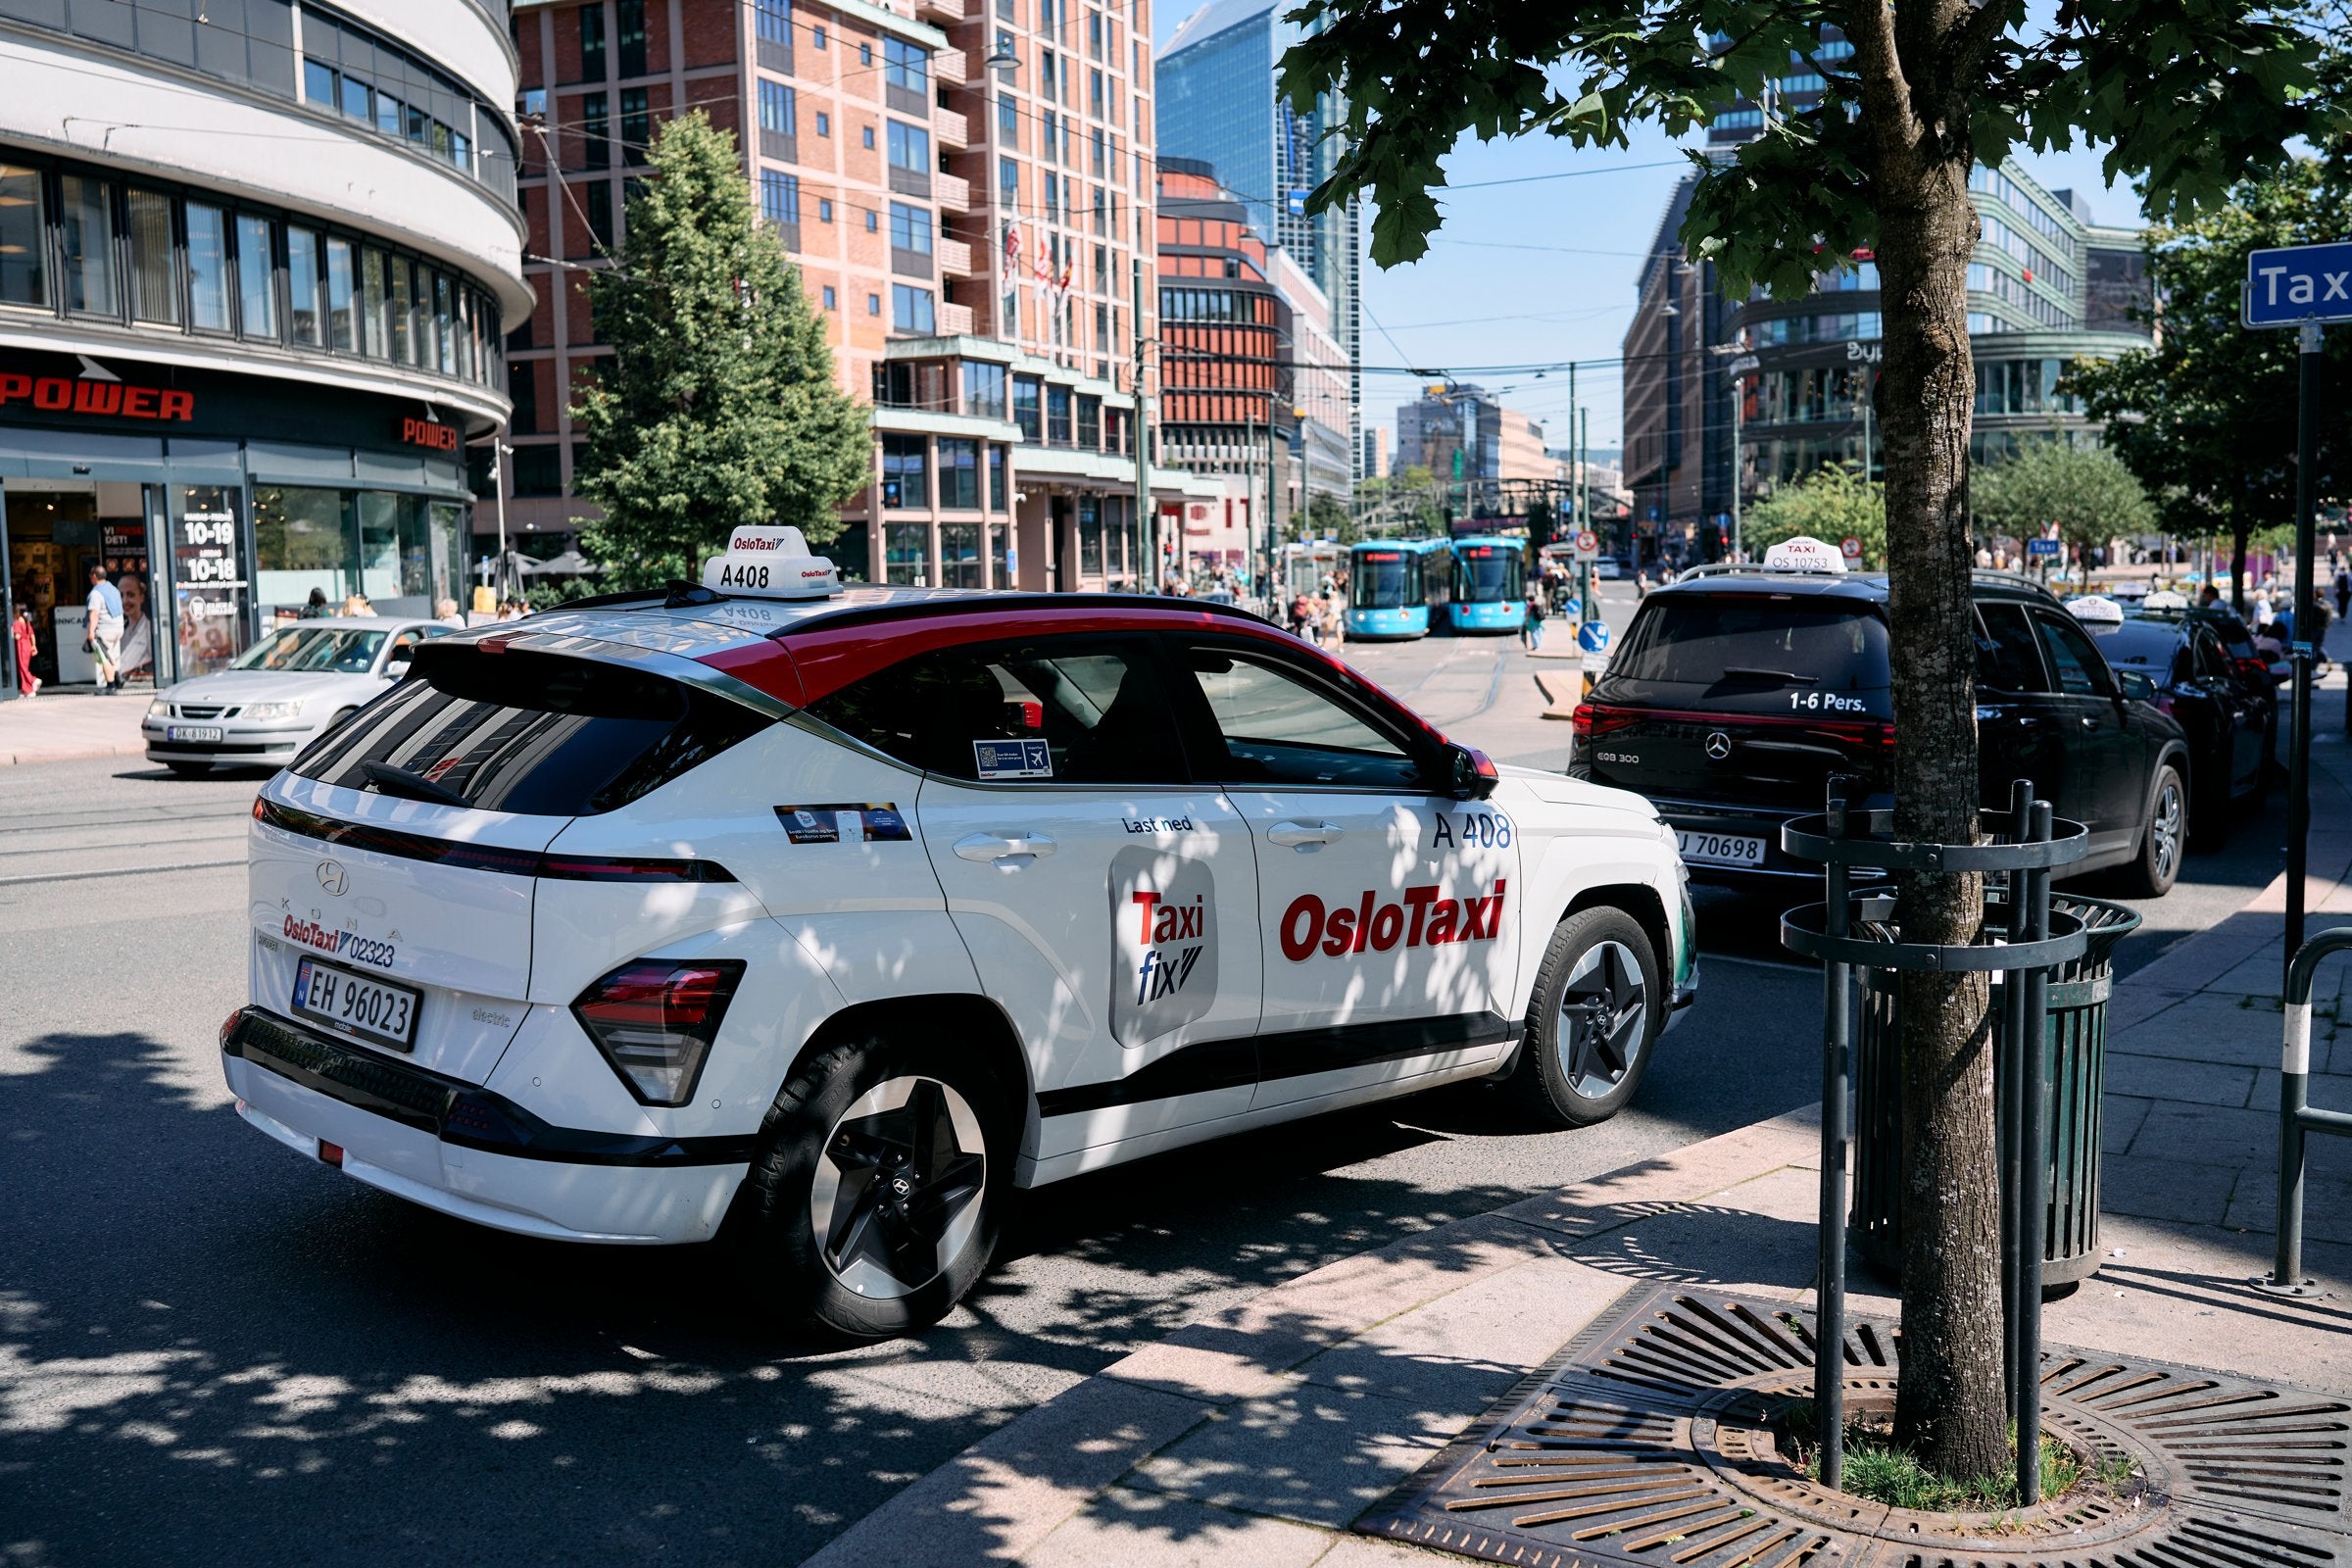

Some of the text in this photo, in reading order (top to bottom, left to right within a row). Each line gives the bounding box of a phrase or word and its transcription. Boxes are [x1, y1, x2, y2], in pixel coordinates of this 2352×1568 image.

[2258, 266, 2350, 306] Tax
[0, 372, 194, 421] POWER
[403, 416, 458, 451] POWER
[184, 521, 233, 545] 10-19
[734, 537, 776, 550] OsloTaxi
[1787, 545, 1816, 554] TAXI
[187, 558, 236, 581] 10-18
[801, 569, 828, 578] OsloTaxi
[1772, 557, 1828, 568] OS 10753
[720, 564, 769, 588] A408
[1790, 692, 1867, 712] 1-6 Pers.
[1596, 752, 1640, 764] EQB 300
[1121, 814, 1194, 834] Last ned
[1433, 812, 1511, 849] A 408
[1696, 835, 1758, 859] 70698
[1132, 892, 1203, 945] Taxi
[1279, 878, 1506, 962] OsloTaxi
[283, 913, 339, 954] OsloTaxi
[350, 936, 395, 968] 02323
[1137, 950, 1179, 1006] fix
[297, 970, 410, 1035] N EH 96023
[472, 1007, 511, 1028] electric
